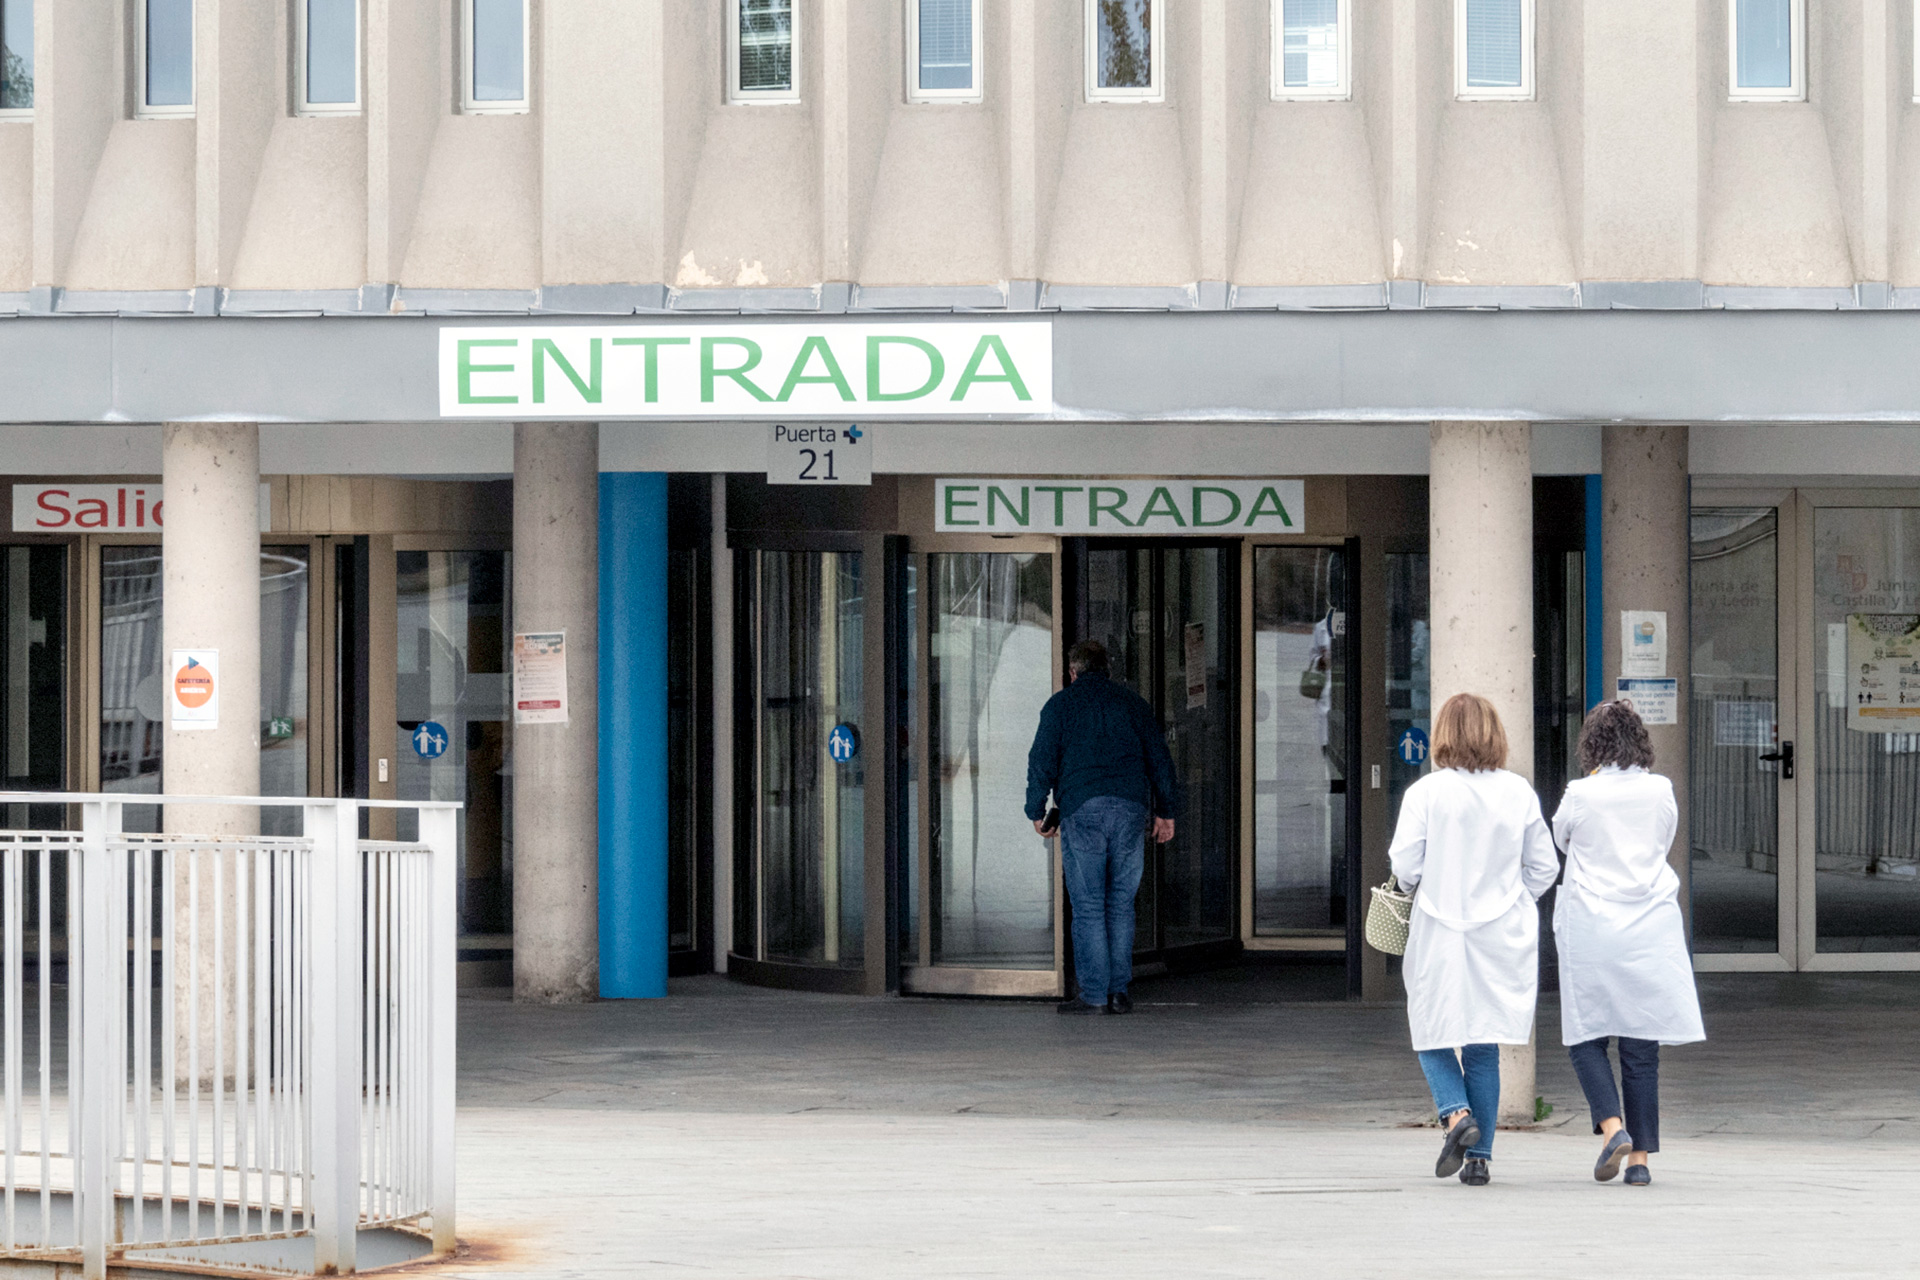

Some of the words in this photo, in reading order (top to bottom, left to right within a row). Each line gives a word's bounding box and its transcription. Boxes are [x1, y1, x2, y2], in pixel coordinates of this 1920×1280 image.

[457, 334, 1033, 404] ENTRADA
[775, 425, 836, 442] Puerta
[799, 448, 838, 480] 21
[944, 486, 1293, 527] ENTRADA
[1874, 579, 1917, 591] Junta
[1832, 593, 1886, 606] Castilla
[1889, 597, 1900, 610] y
